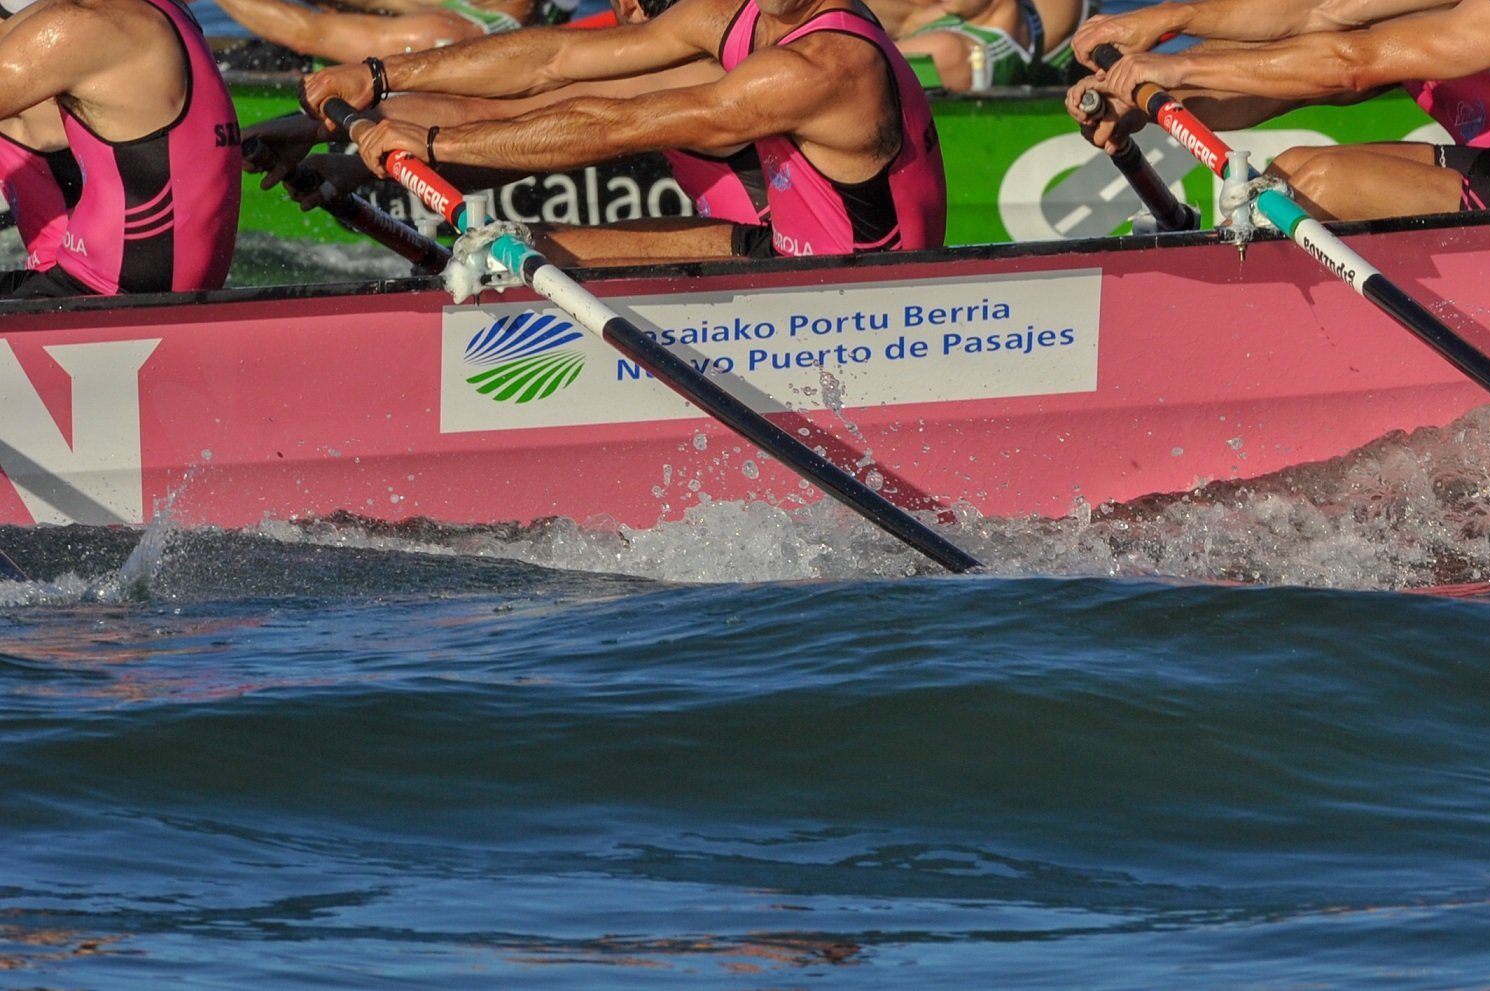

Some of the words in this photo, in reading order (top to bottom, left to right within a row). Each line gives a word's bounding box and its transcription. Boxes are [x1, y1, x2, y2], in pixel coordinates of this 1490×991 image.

[1171, 119, 1218, 169] MAPFRE
[400, 166, 450, 216] MAPFRE
[640, 317, 775, 347] asaiako
[790, 310, 889, 337] Portu
[904, 298, 1011, 327] Berria
[617, 356, 735, 381] Nvo
[749, 343, 872, 372] Puerto
[885, 335, 929, 359] de
[943, 325, 1075, 355] Pasajes
